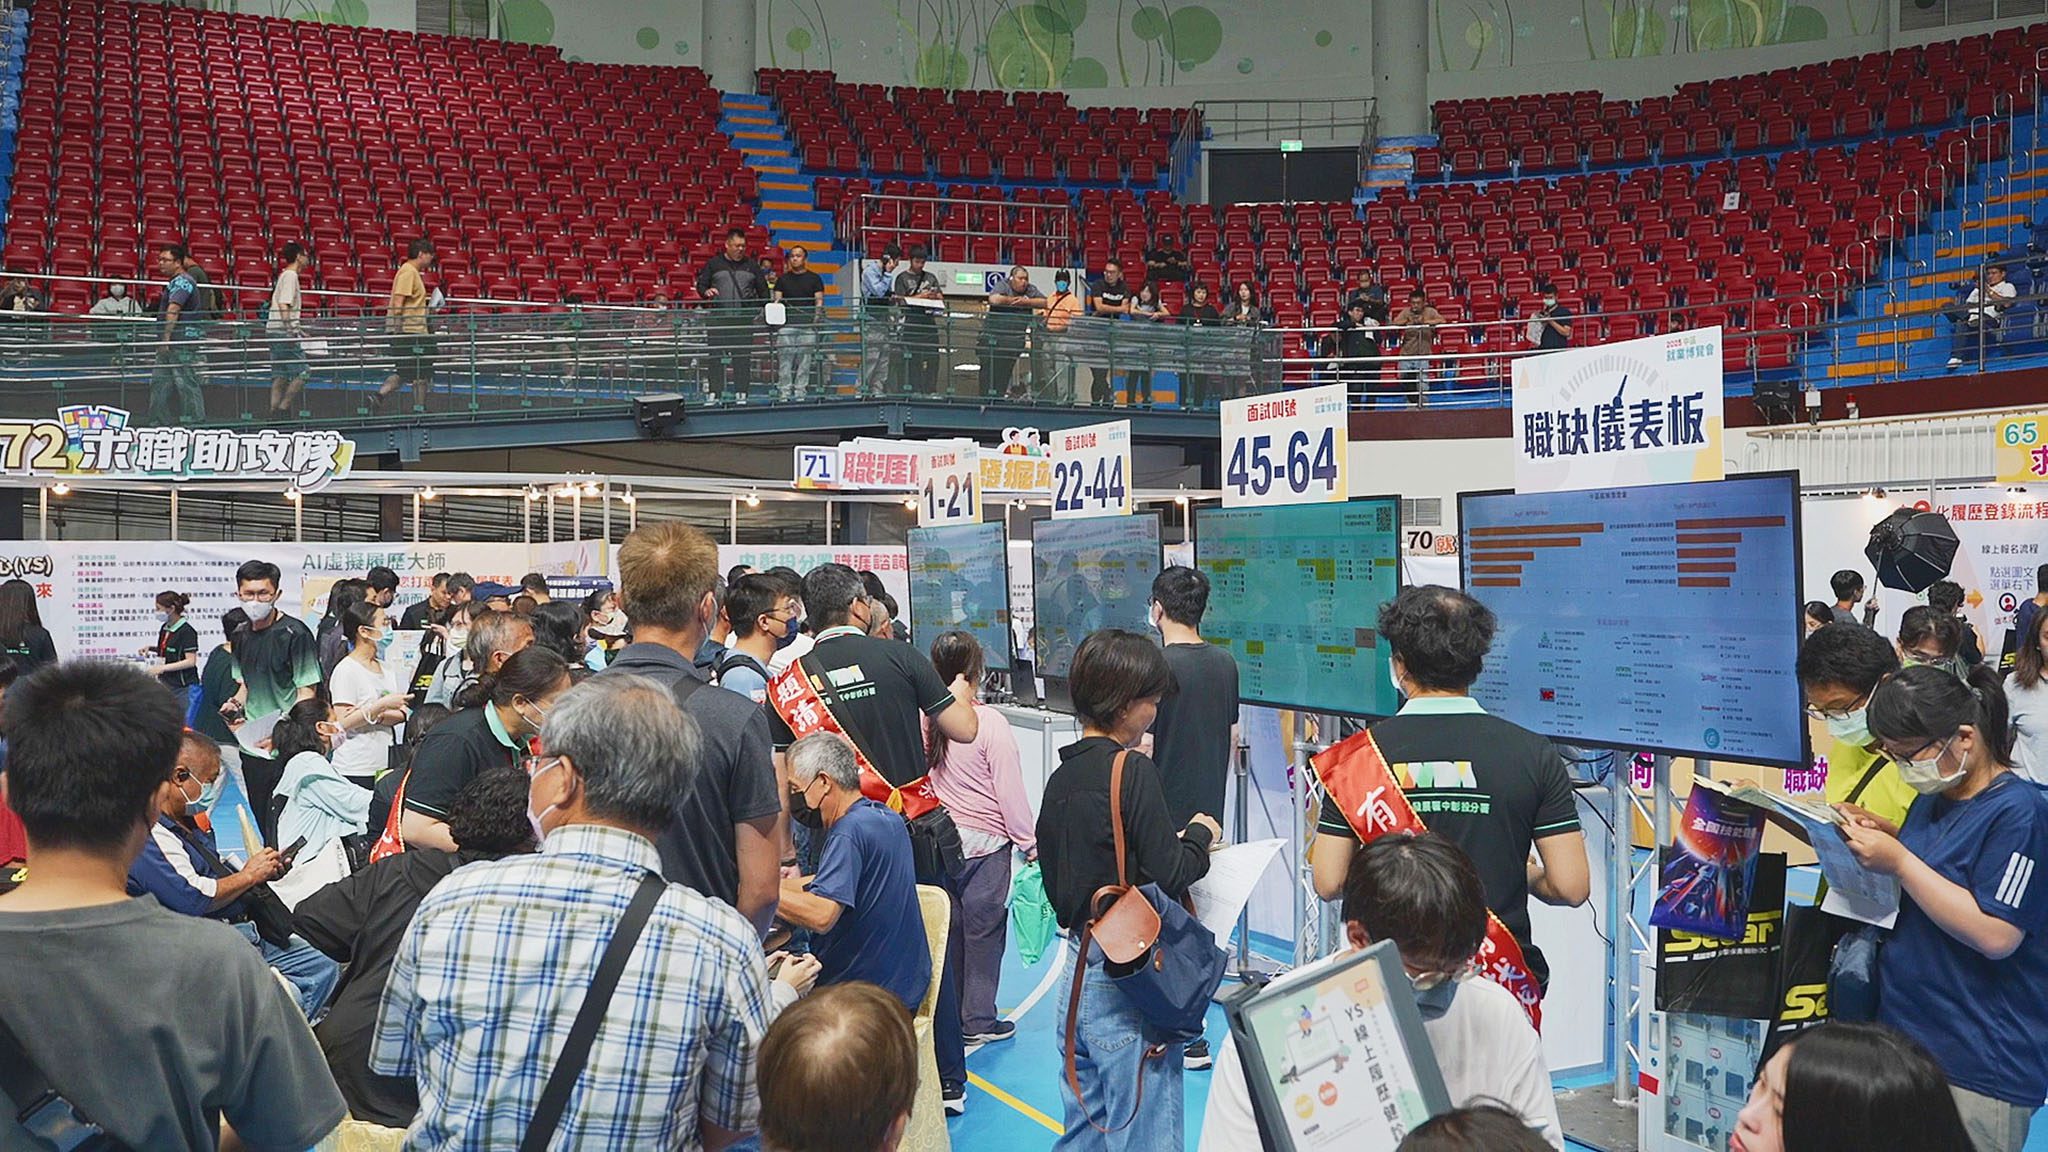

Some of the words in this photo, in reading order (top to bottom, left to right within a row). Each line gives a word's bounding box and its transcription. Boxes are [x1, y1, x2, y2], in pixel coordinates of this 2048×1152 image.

[1247, 398, 1297, 422] 面試叫號
[1523, 391, 1705, 459] 職缺儀表板
[2004, 422, 2038, 445] 65
[1065, 432, 1097, 451] 面試叫號
[0, 424, 68, 469] 72
[78, 428, 340, 488] 求職助攻隊
[804, 454, 831, 479] 71
[1227, 427, 1337, 497] 45-64
[1054, 455, 1125, 511] 22-44
[924, 471, 975, 520] 1-21
[1407, 531, 1433, 549] 70
[1981, 544, 2039, 555] 線上報名流程
[302, 552, 446, 571] AI虛擬履歷大師
[1989, 566, 2034, 578] 點選圖文
[36, 582, 53, 599] 來
[1357, 786, 1397, 833] 有
